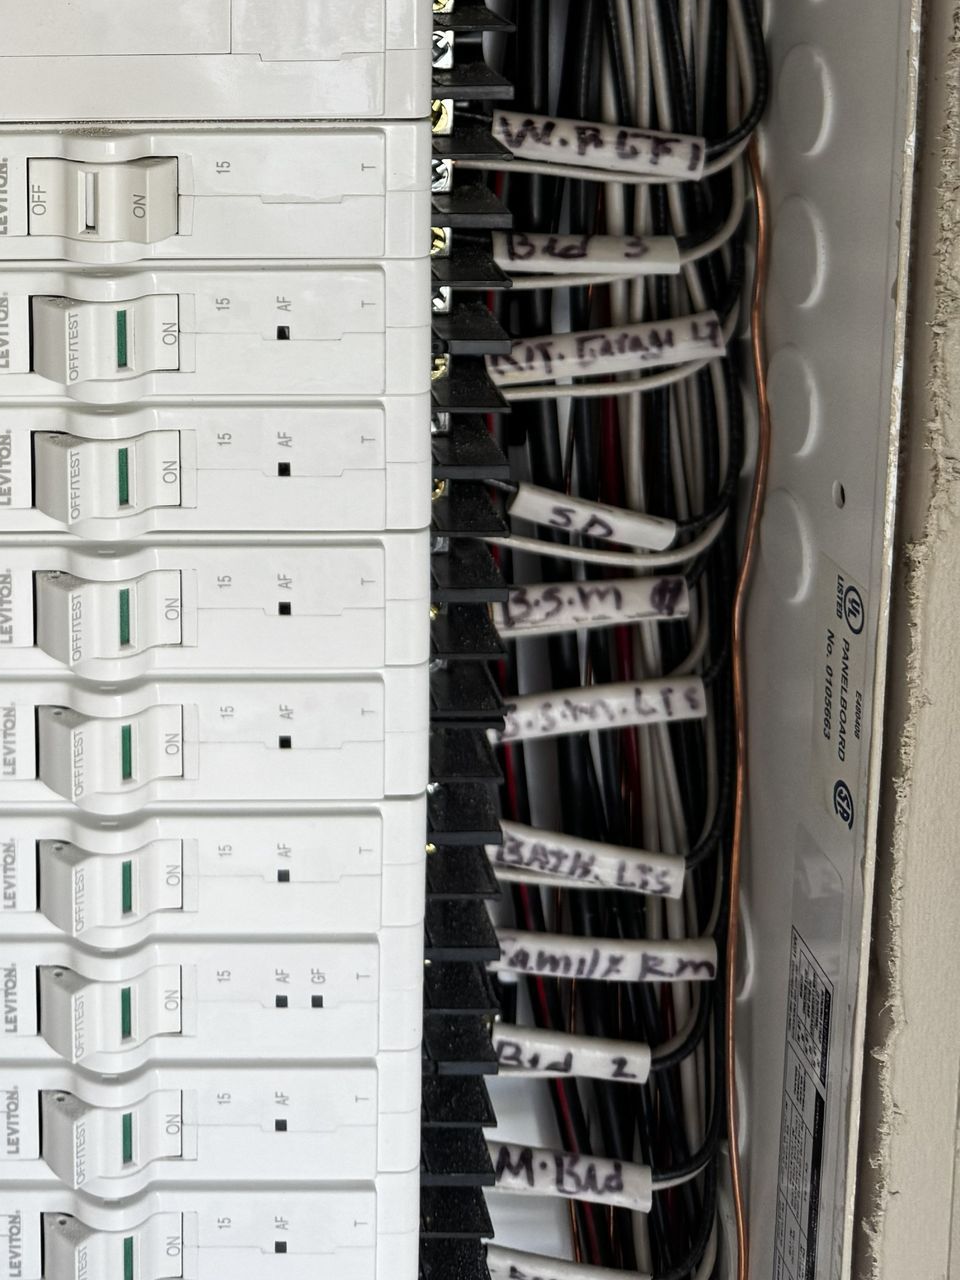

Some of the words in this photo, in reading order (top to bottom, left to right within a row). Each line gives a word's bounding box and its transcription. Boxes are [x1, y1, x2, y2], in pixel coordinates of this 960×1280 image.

[216, 161, 230, 174] 15
[32, 185, 46, 215] OFF
[133, 194, 146, 218] ON
[624, 236, 649, 258] 3
[216, 298, 230, 311] 15
[277, 296, 291, 311] AF
[218, 433, 232, 446] 15
[0, 435, 11, 505] LEVITON
[549, 506, 614, 538] SD
[217, 576, 231, 588] 15
[0, 575, 13, 644] LEVITON
[826, 628, 834, 656] No.
[823, 666, 833, 740] 0105663
[837, 638, 850, 761] PANELBOARD
[220, 706, 234, 718] 15
[3, 707, 16, 775] LEVITON
[218, 845, 232, 857] 15
[3, 843, 16, 908] LEVITON
[217, 970, 231, 982] 15
[6, 968, 17, 1033] LEVITON
[611, 1056, 637, 1078] 2
[217, 1093, 231, 1104] 15
[7, 1091, 18, 1154] LEVITON
[218, 1218, 231, 1229] 15
[10, 1215, 22, 1278] LEVITON
